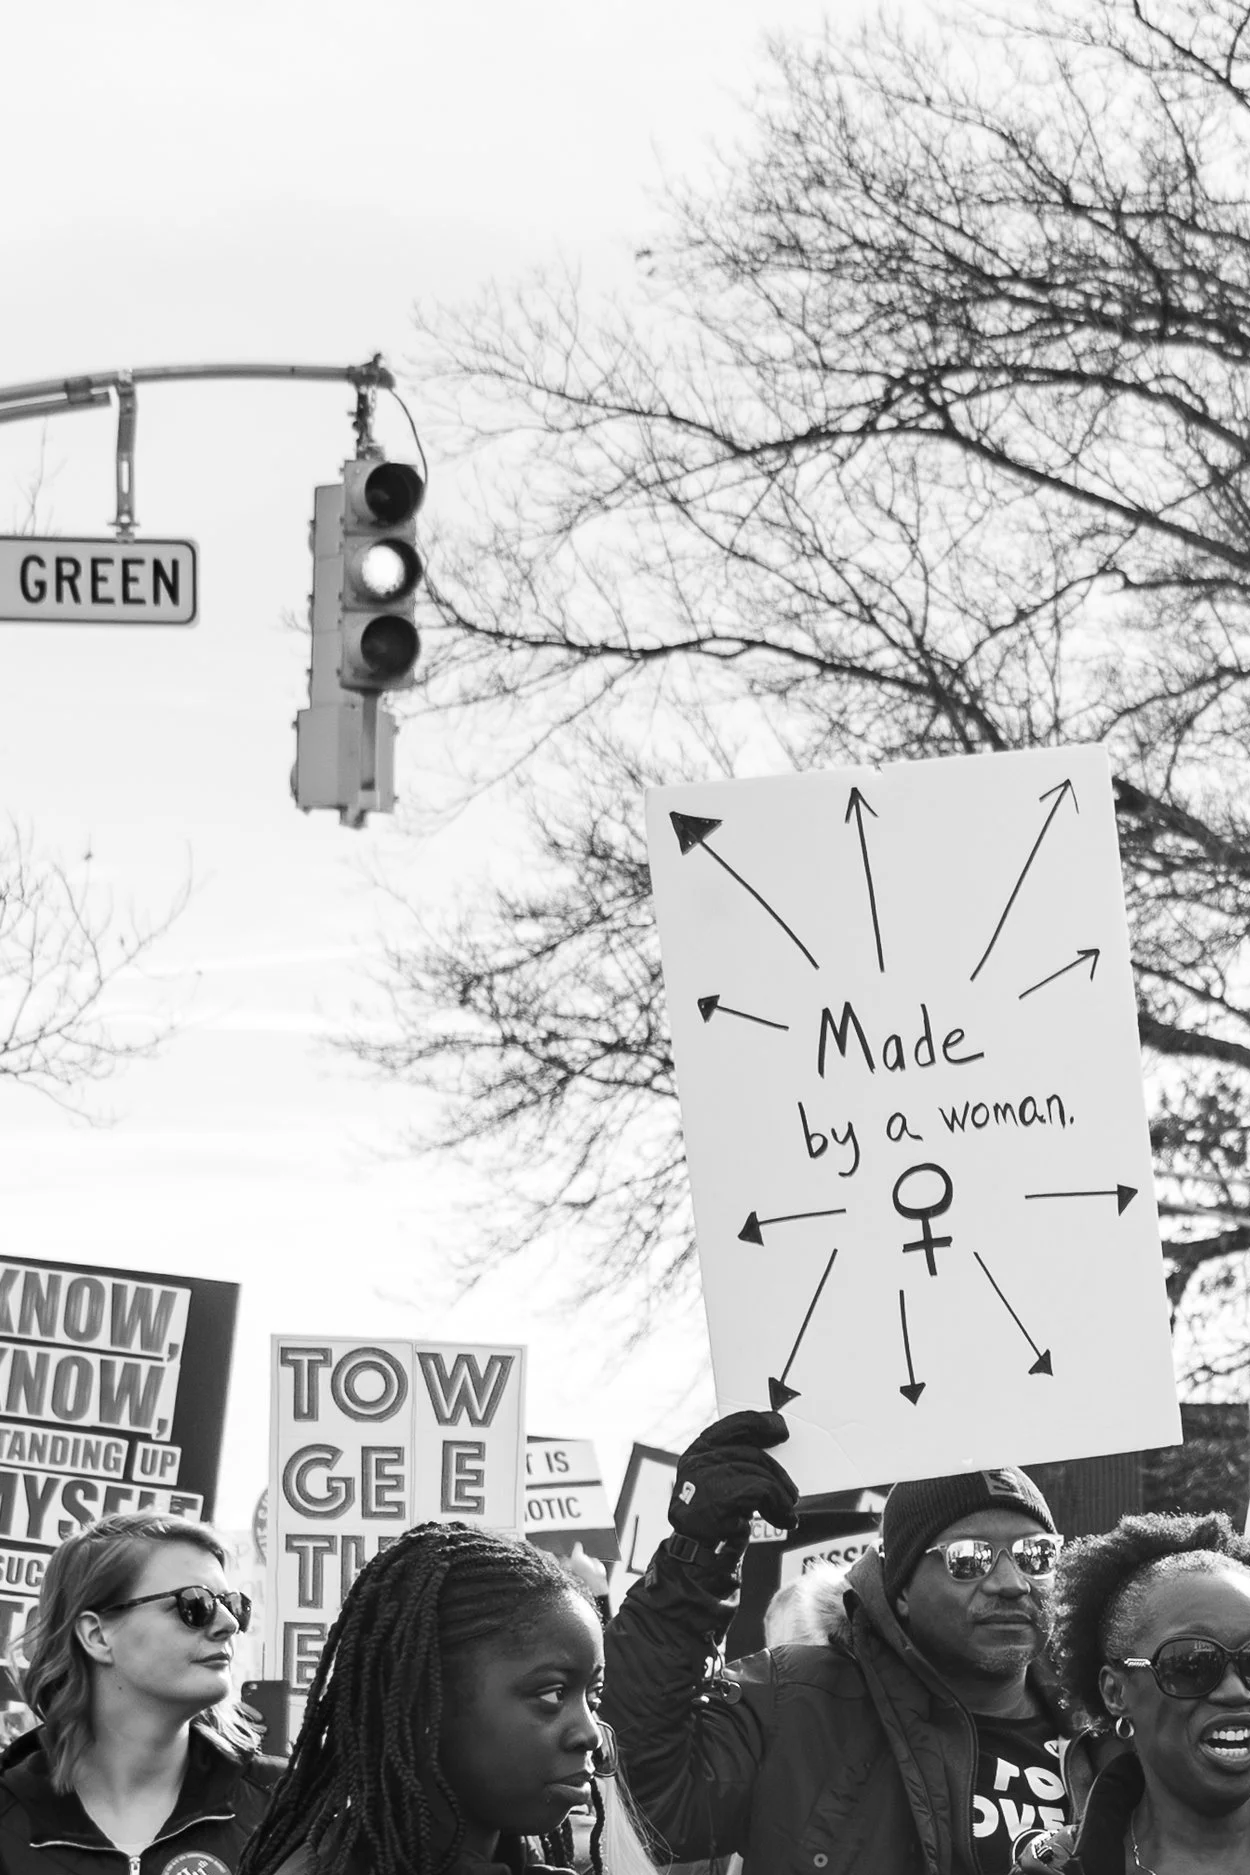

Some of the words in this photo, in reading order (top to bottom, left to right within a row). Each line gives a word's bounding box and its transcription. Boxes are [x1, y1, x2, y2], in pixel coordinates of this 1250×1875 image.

[20, 555, 180, 606] GREEN
[818, 1002, 985, 1078] Made
[798, 1102, 860, 1177] by
[886, 1112, 923, 1142] a
[939, 1093, 1076, 1133] woman.
[0, 1347, 169, 1438] NOW,
[140, 1447, 178, 1478] UP
[545, 1450, 570, 1474] IS
